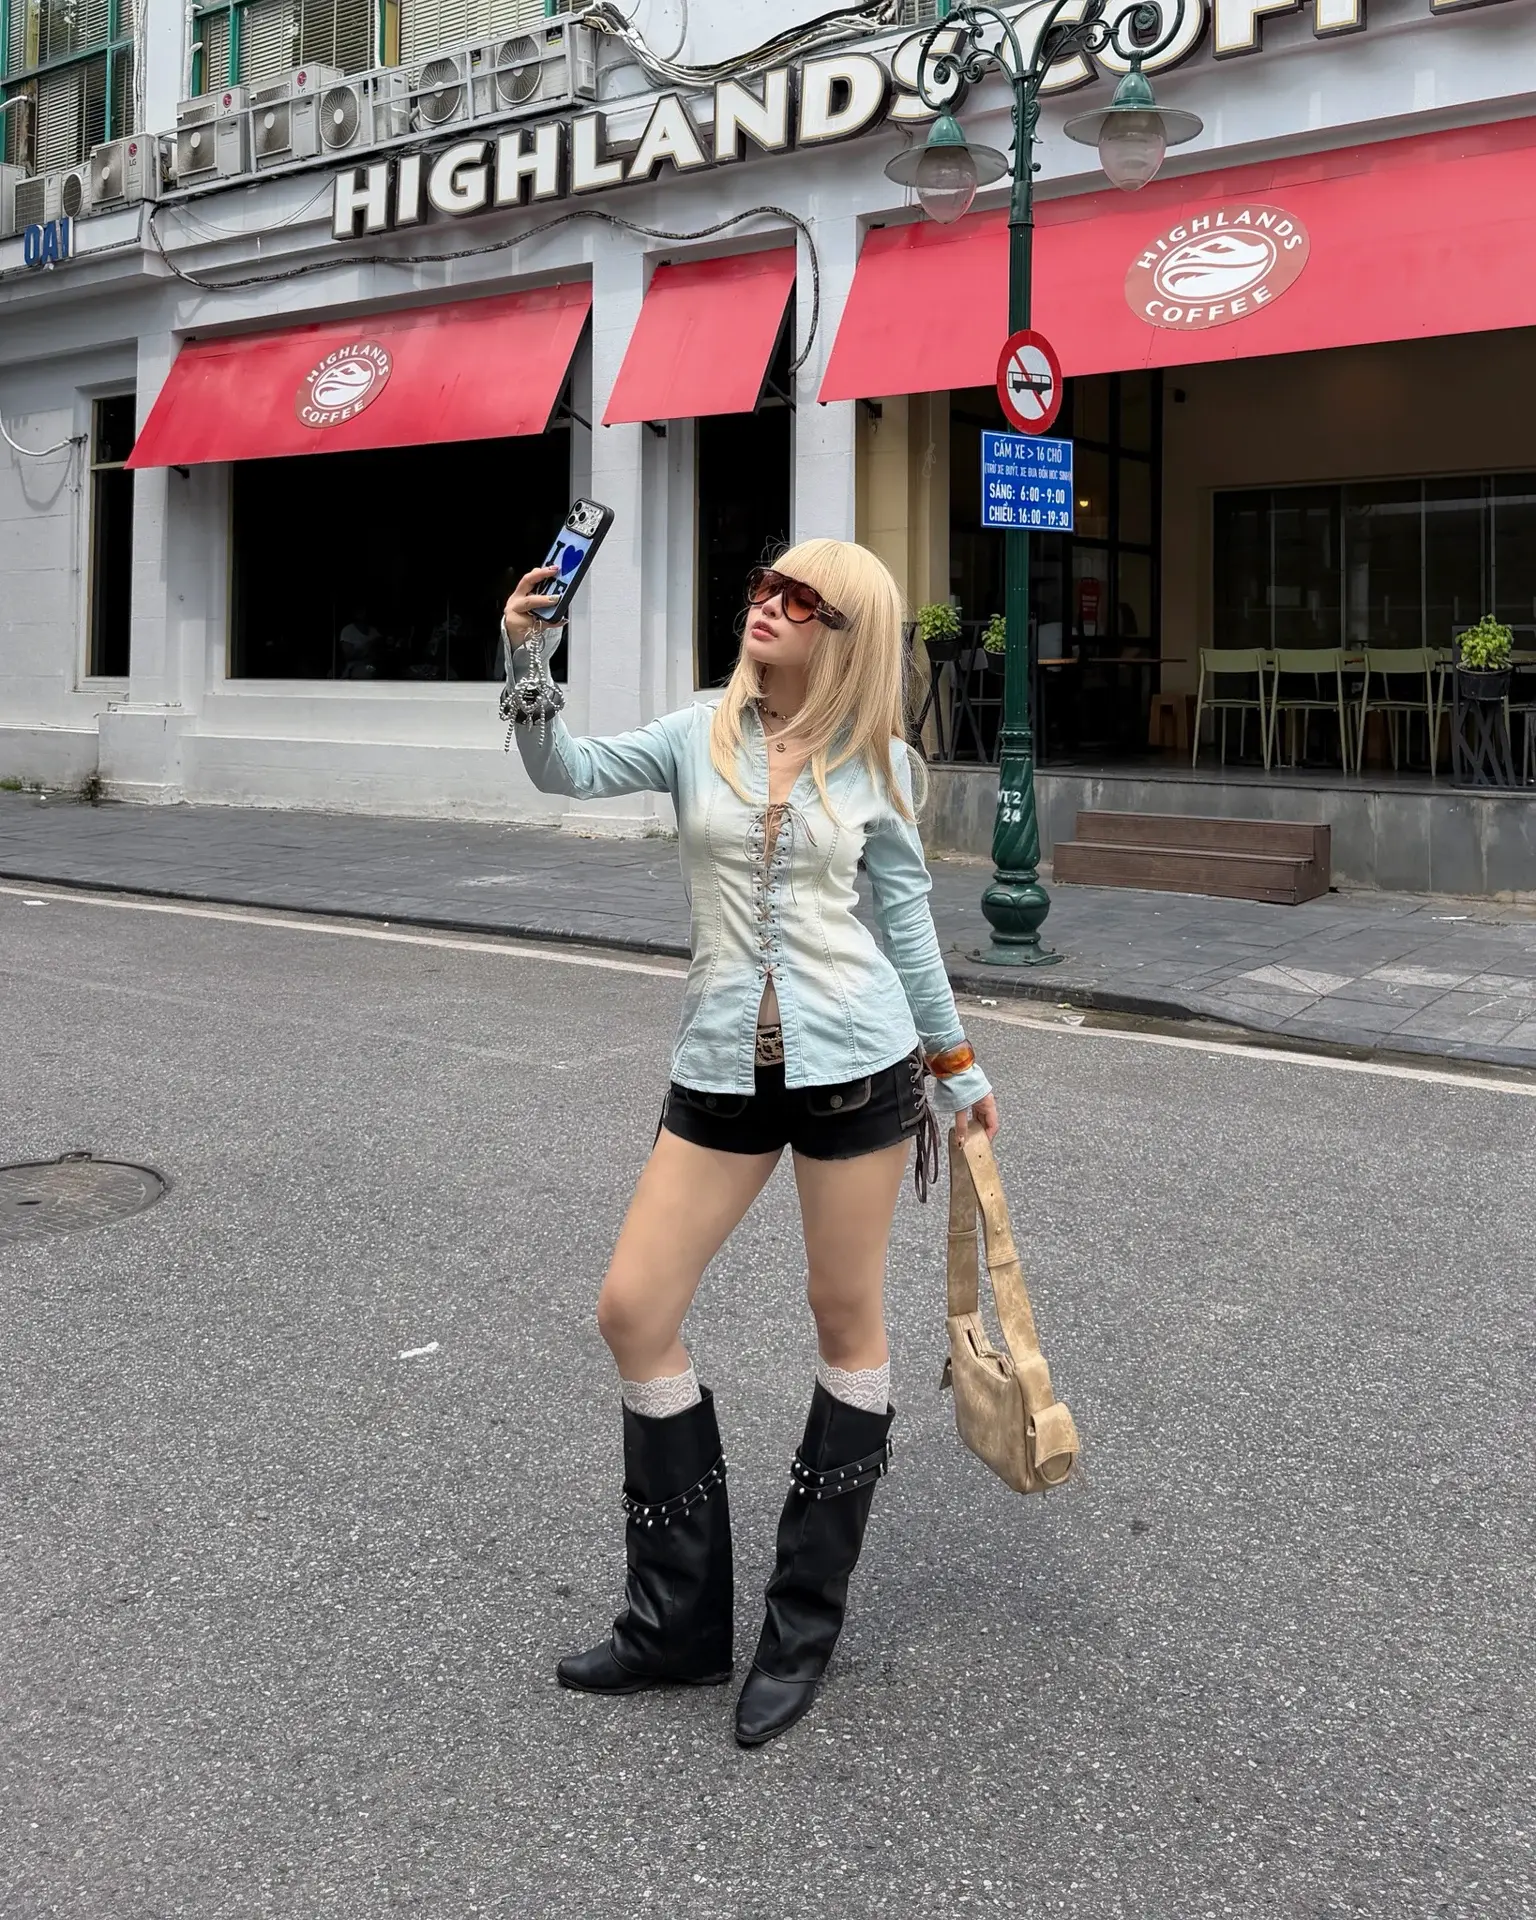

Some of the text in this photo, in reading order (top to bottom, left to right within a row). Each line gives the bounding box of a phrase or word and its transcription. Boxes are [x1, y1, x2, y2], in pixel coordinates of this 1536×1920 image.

[333, 27, 968, 240] HIGHLANDS
[129, 158, 137, 166] LG
[1137, 210, 1303, 269] HIGHLANDS
[1145, 285, 1273, 323] COFFEE
[306, 344, 389, 383] HIGHLANDS
[301, 400, 364, 423] COFFEE
[994, 438, 1012, 459] CẤM
[1014, 444, 1026, 459] XE
[1036, 446, 1045, 462] 16
[997, 464, 1004, 475] XE
[1020, 467, 1027, 478] XE
[989, 480, 1015, 500] SÁNG:
[989, 501, 1016, 522] CHIỀU:
